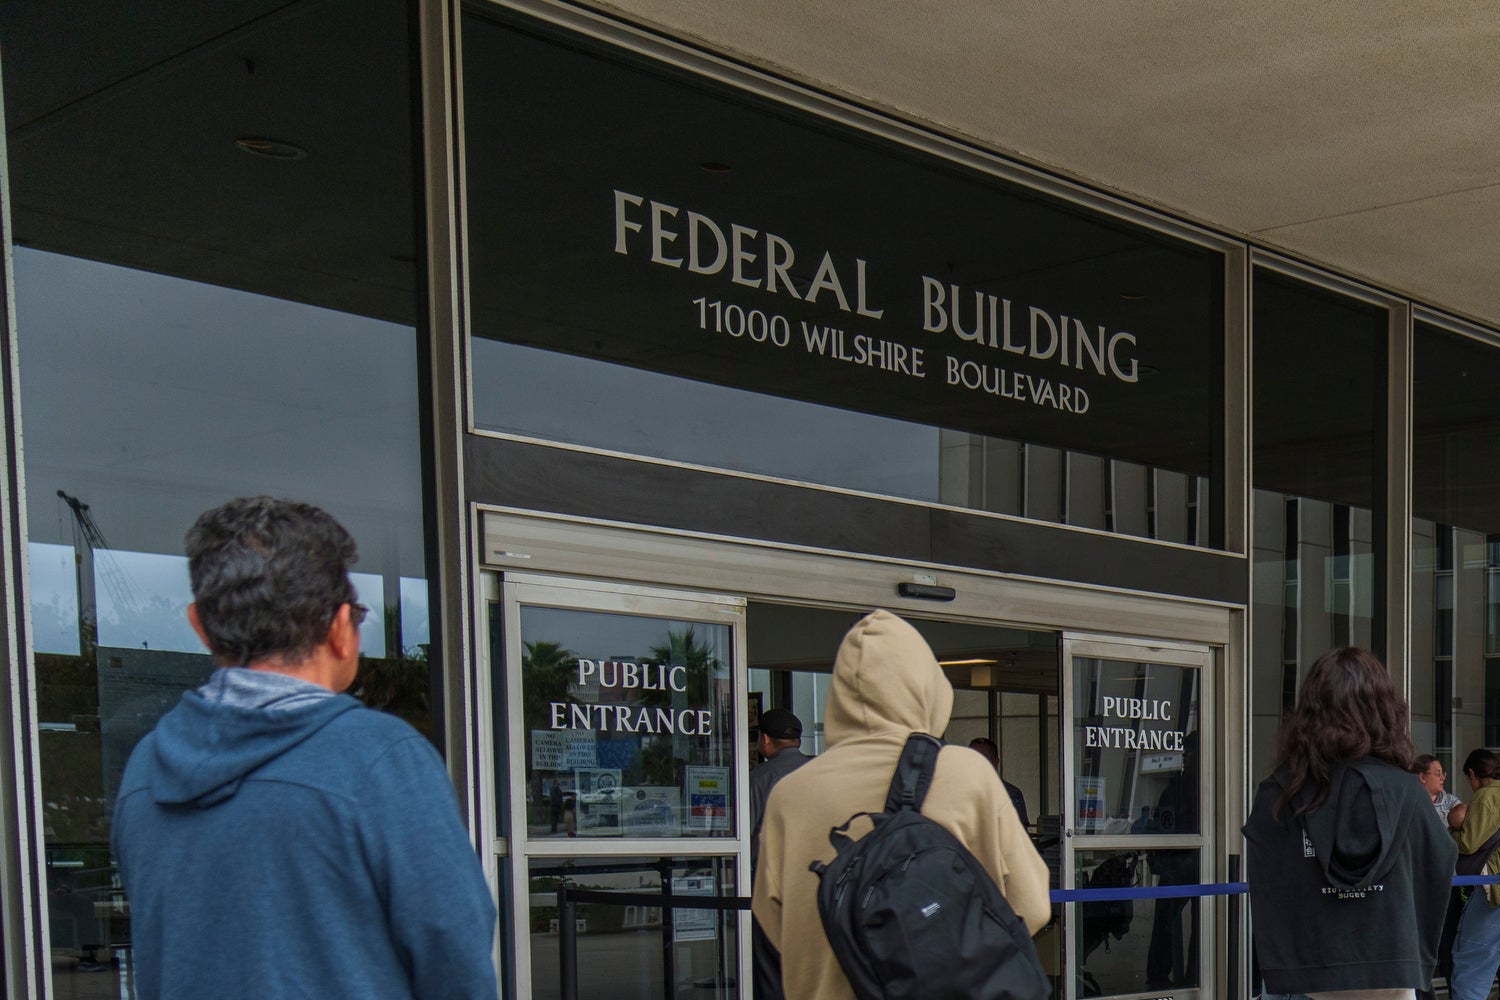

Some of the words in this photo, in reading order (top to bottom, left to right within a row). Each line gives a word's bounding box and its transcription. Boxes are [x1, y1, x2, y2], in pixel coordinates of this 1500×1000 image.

[613, 189, 884, 320] FEDERAL
[922, 275, 1139, 383] BUILDING
[692, 297, 791, 347] 11000
[801, 321, 926, 379] WILSHIRE
[946, 356, 1090, 414] BOULEVARD
[578, 658, 687, 692] PUBLIC
[550, 702, 713, 736] ENTRANCE
[1103, 696, 1171, 721] PUBLIC
[1085, 726, 1184, 752] ENTRANCE
